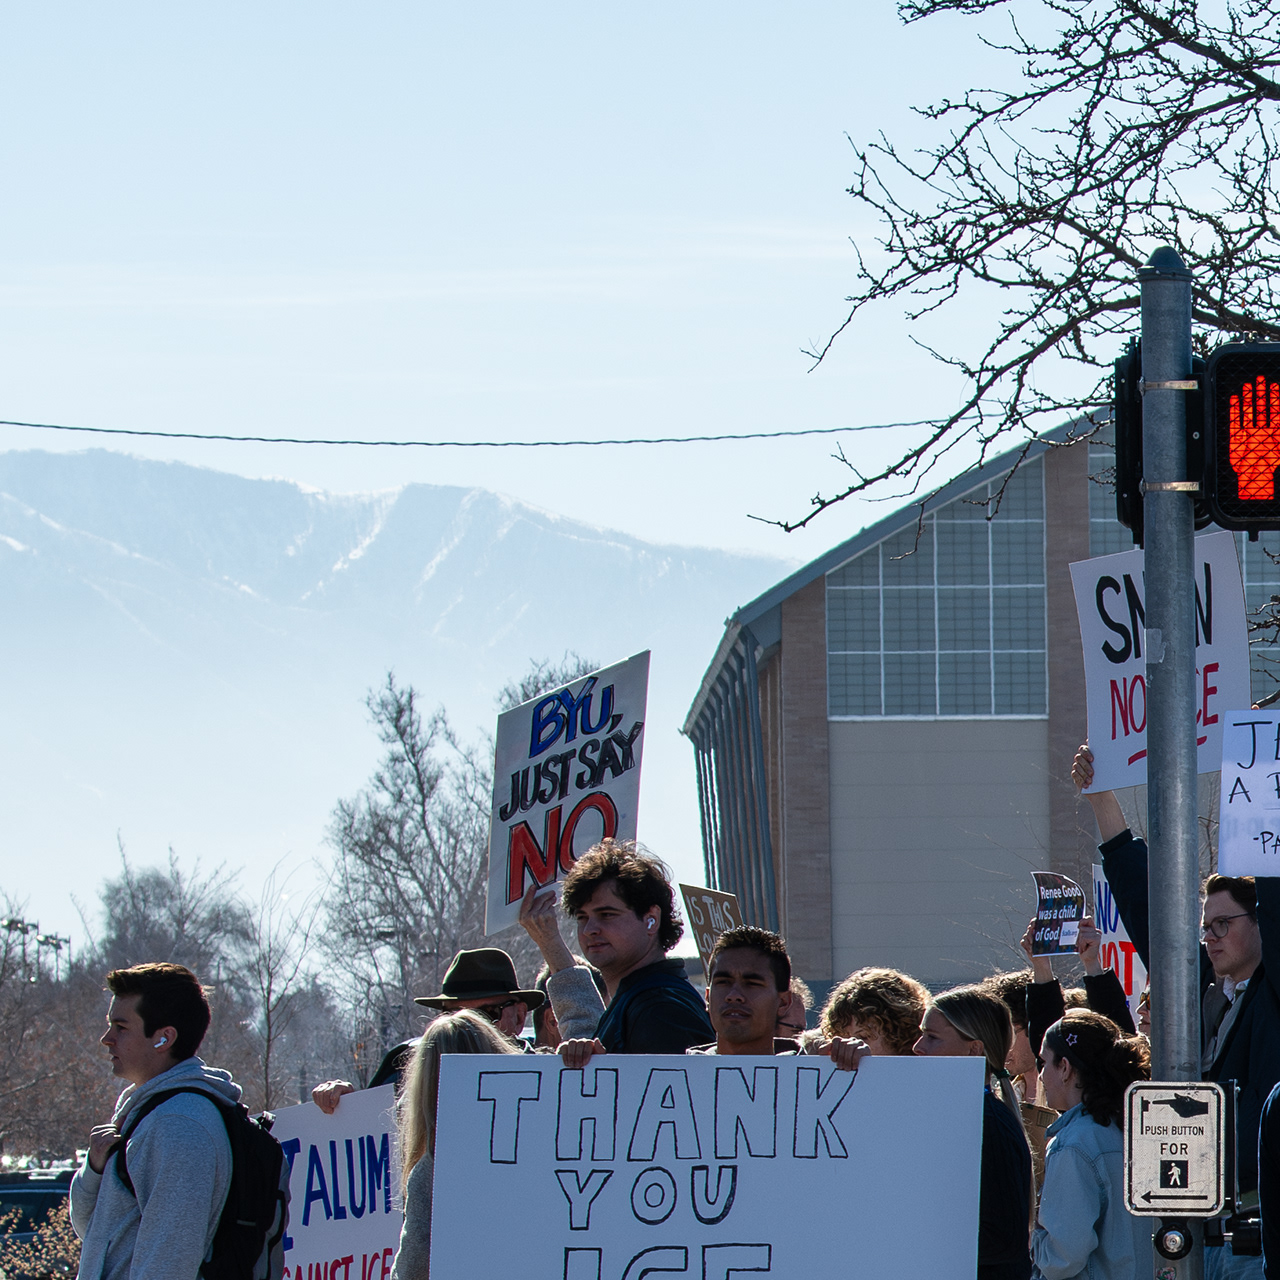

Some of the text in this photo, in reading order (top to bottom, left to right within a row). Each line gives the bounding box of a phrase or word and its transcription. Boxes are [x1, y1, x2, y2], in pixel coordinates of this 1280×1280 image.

[529, 677, 623, 758] BYU,
[500, 722, 644, 822] JUST SAY
[1228, 777, 1251, 803] A
[505, 791, 618, 905] NO
[1040, 885, 1081, 899] Renee Good
[685, 894, 704, 925] IS
[1039, 905, 1077, 920] was a child
[1035, 927, 1044, 941] of
[477, 1067, 858, 1164] THANK
[1145, 1126, 1204, 1136] PUSH BUTTON
[1160, 1142, 1189, 1155] FOR
[555, 1165, 737, 1230] YOU
